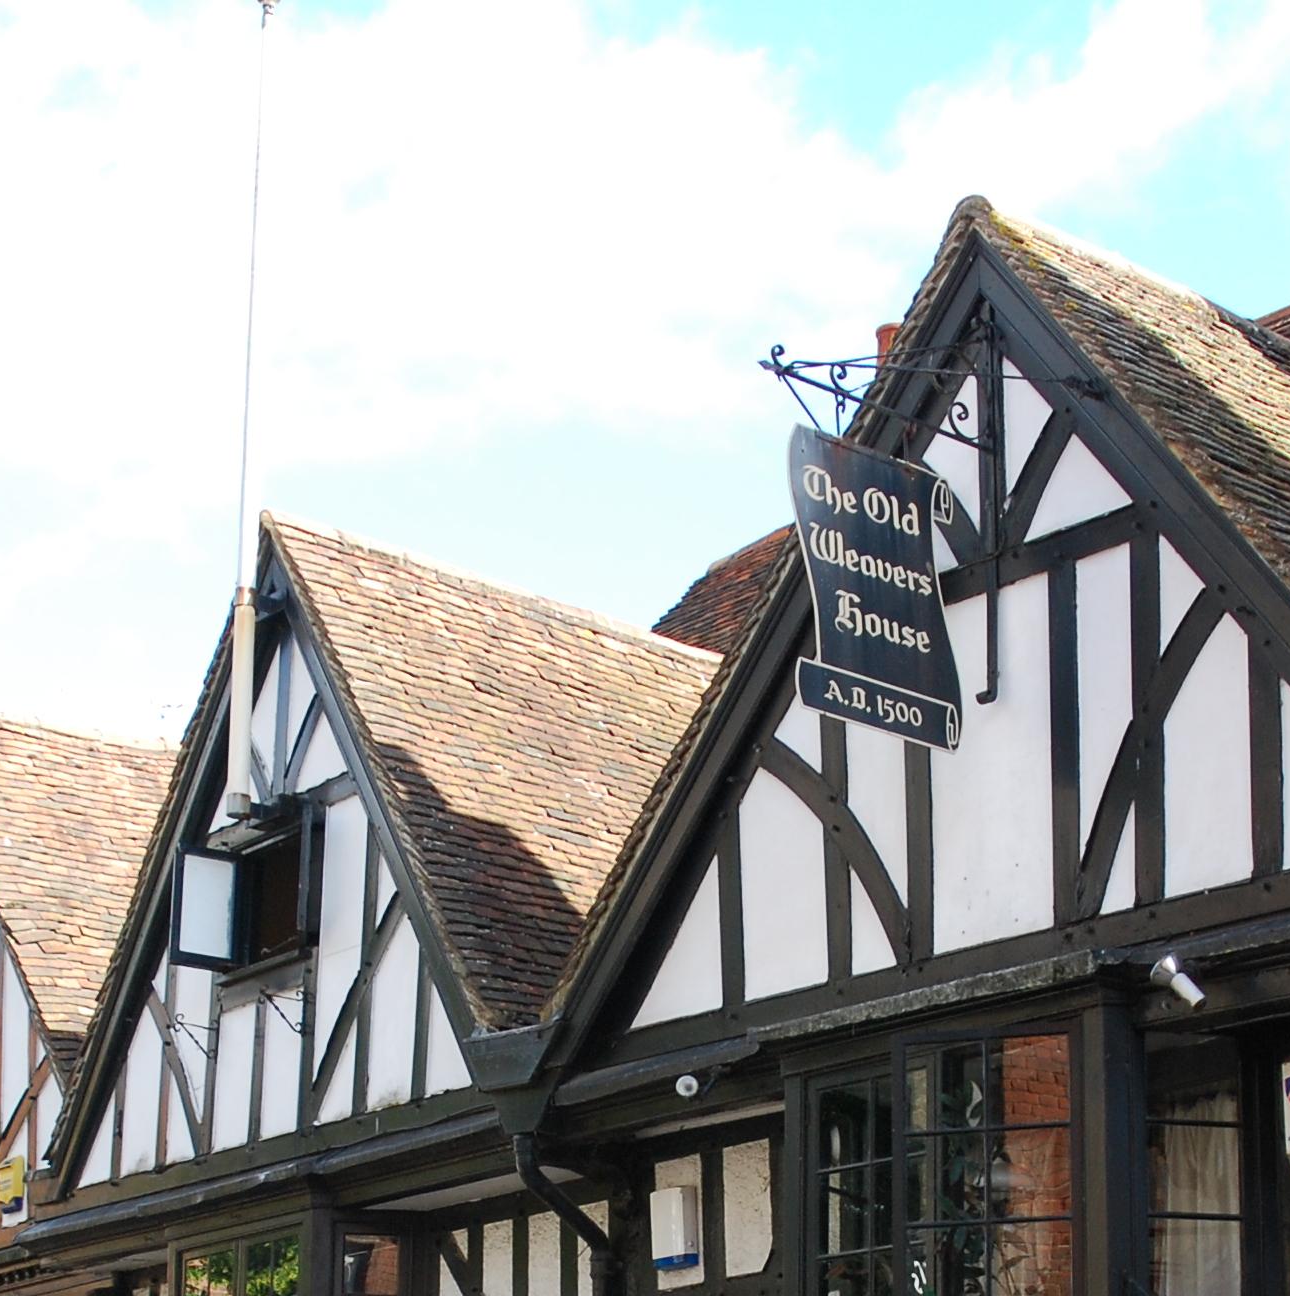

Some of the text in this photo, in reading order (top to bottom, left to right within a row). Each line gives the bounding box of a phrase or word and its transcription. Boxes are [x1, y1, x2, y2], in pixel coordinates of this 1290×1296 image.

[803, 465, 920, 536] The Old
[809, 522, 933, 596] Weavers
[834, 589, 931, 654] House
